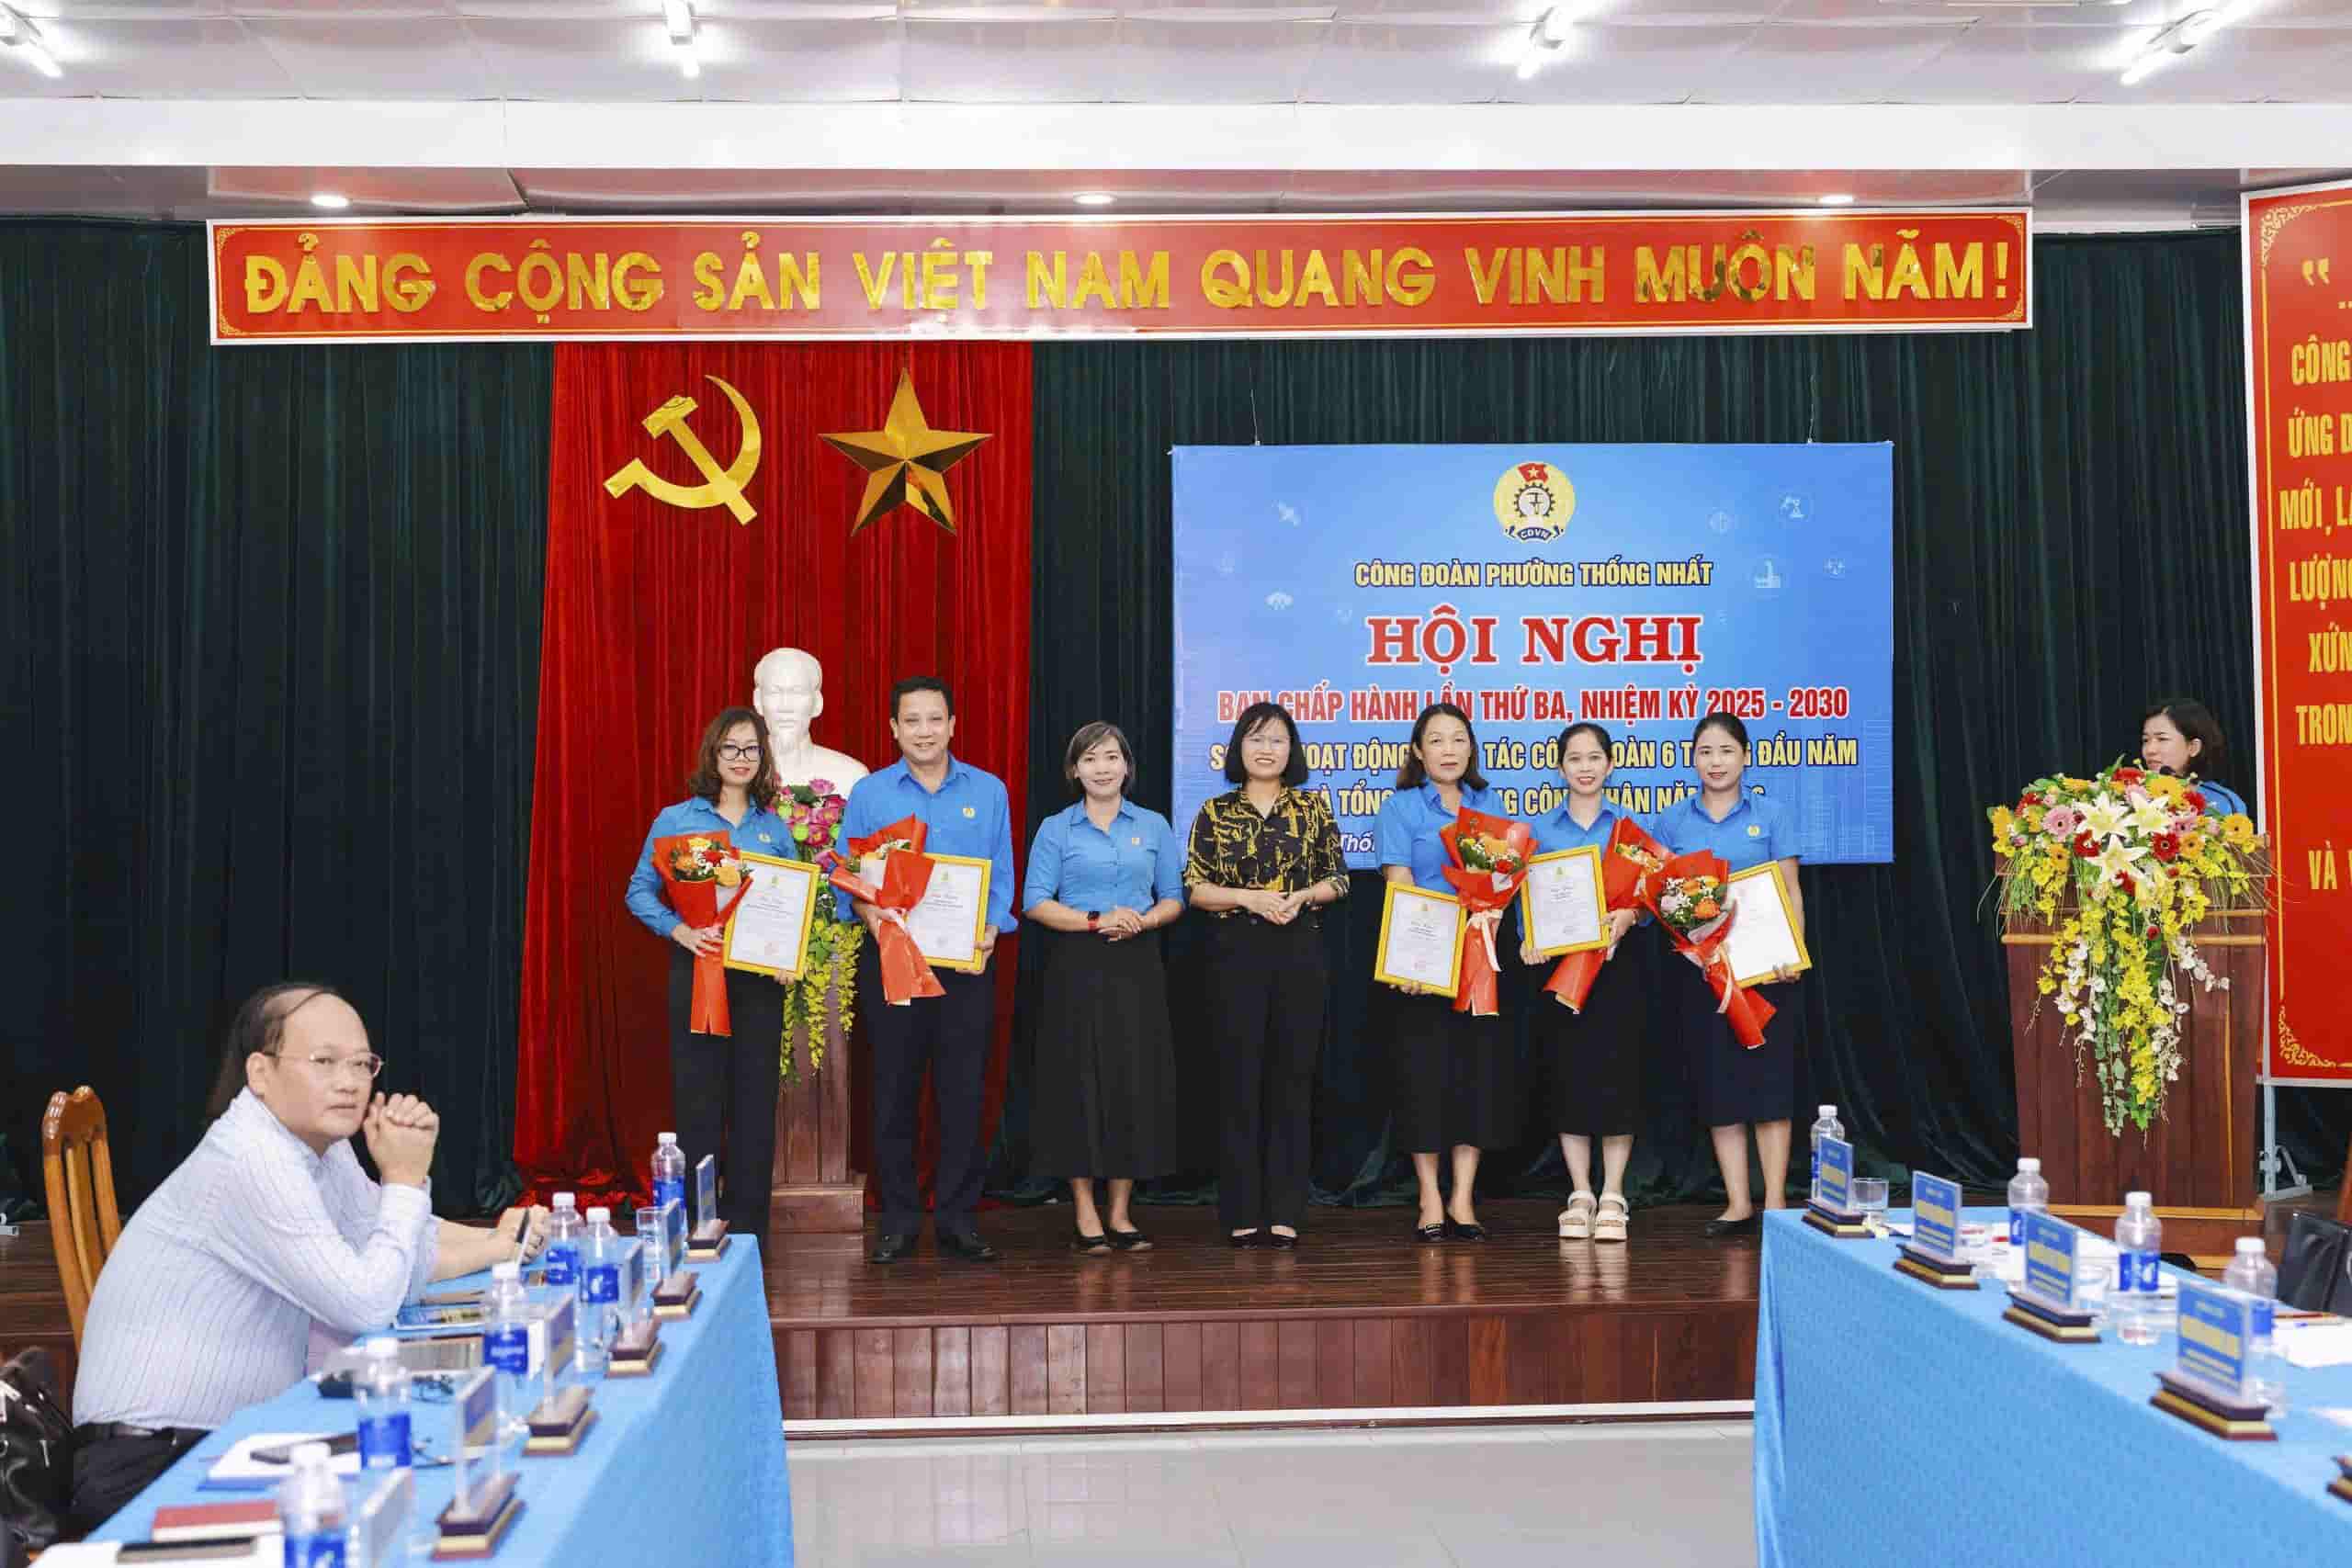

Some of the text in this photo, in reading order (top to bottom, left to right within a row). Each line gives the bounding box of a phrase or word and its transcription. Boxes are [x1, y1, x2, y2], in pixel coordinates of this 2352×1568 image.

[243, 231, 435, 314] ĐẢNG
[464, 238, 663, 323] CỘNG
[692, 231, 821, 310] SẢN
[1026, 248, 1170, 309] NAM
[1201, 247, 1436, 309] QUANG
[1464, 245, 1605, 305] VINH
[1634, 229, 1816, 302] MUÔN
[1843, 228, 2009, 301] NĂM!
[2291, 334, 2352, 385] CÔNG
[2288, 406, 2334, 457] ỨNG
[1354, 554, 1713, 587] CÔNG ĐOÀN PHƯỜNG THỐNG NHẤT
[1367, 605, 1702, 674] HỘI NGHỊ
[1278, 681, 1344, 721] CHẤP
[1351, 685, 1419, 721] HÀNH
[1480, 685, 1529, 721] THỨ
[1534, 690, 1574, 723] BA,
[1581, 684, 1661, 727] NHIỆM
[1668, 683, 1699, 719] KỲ
[1706, 690, 1765, 718] 2025
[1789, 689, 1848, 717] 2030
[1301, 742, 1348, 776] OẠT
[1483, 736, 1526, 771] TÁC
[1532, 737, 1559, 770] CÔ
[1611, 736, 1657, 769] OÀN
[1661, 740, 1677, 767] 6
[1757, 731, 1802, 767] ĐẦU
[1806, 734, 1858, 766] NĂM
[1338, 779, 1396, 816] TỔN
[1340, 830, 1375, 852] Thố
[2308, 840, 2338, 890] VÀ
